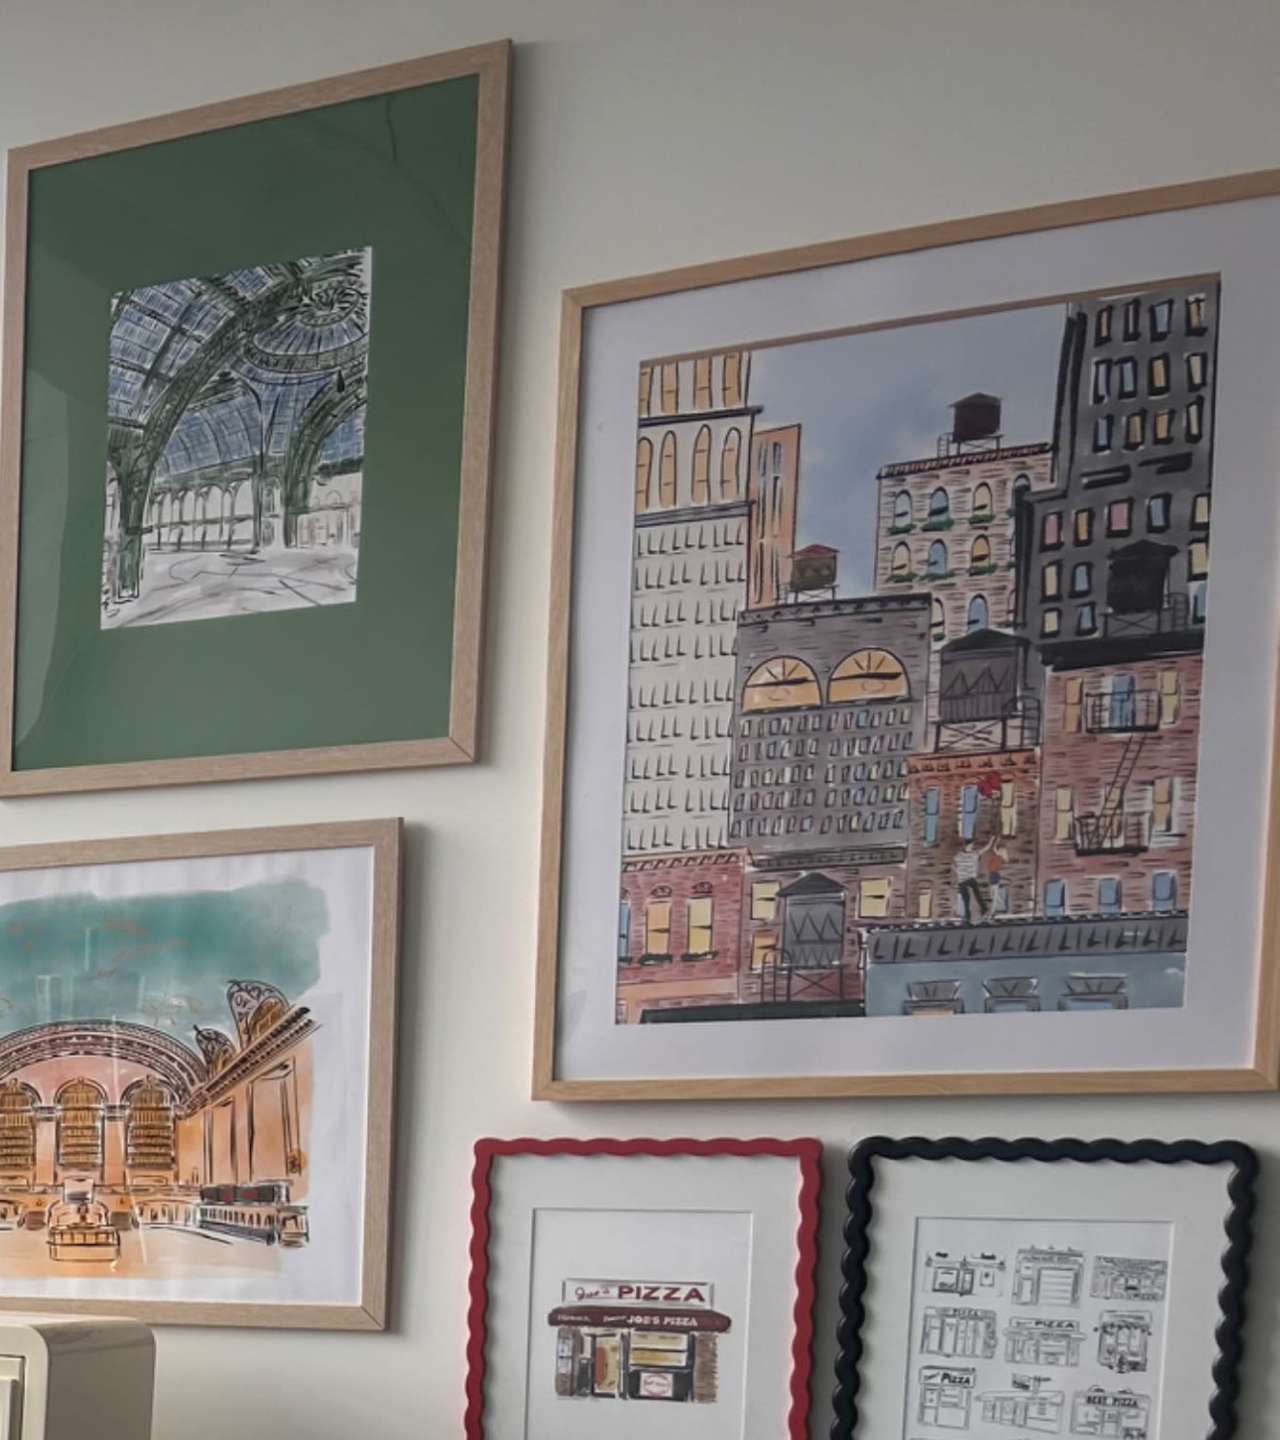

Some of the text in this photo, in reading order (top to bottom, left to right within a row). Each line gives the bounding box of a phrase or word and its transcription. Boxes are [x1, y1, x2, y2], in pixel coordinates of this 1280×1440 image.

[617, 1284, 706, 1303] PIZZA
[662, 1317, 698, 1327] PIZZA
[1034, 1319, 1075, 1329] PIZZA
